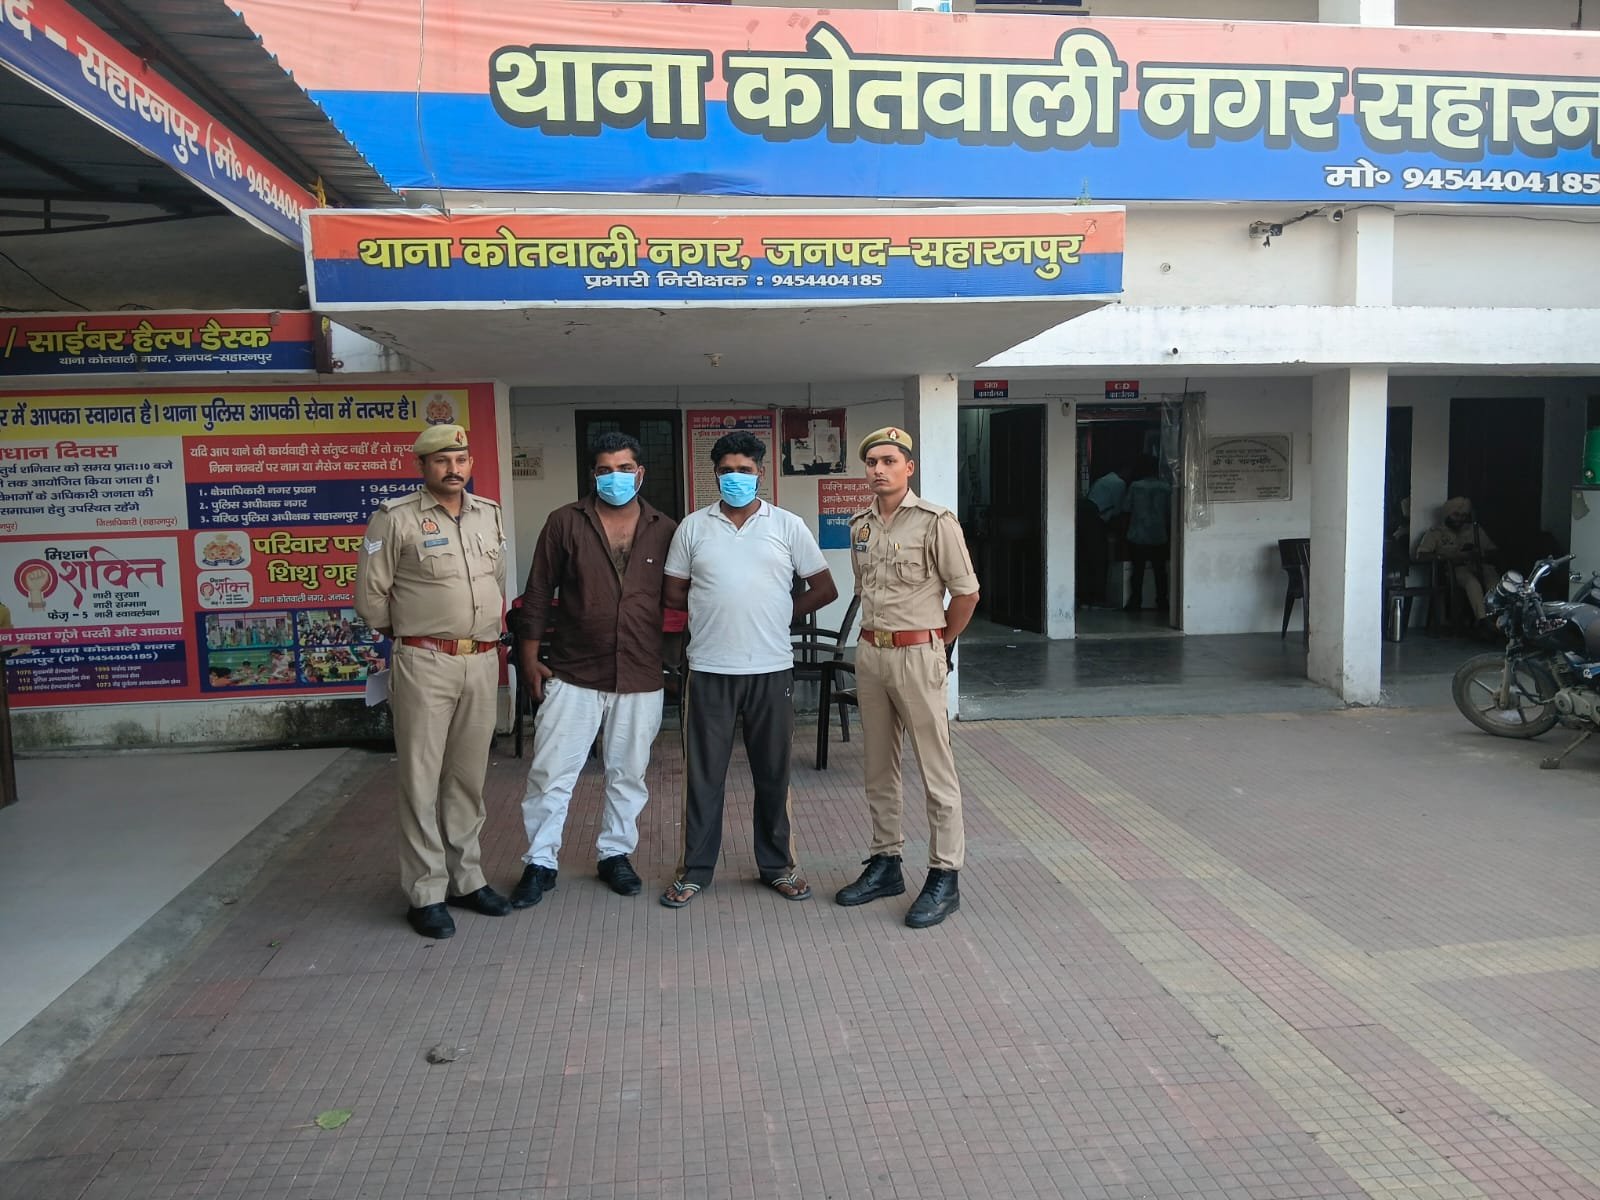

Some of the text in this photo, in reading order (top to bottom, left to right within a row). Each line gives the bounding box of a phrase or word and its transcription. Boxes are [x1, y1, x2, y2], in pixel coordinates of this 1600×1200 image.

[494, 48, 709, 128] थाना
[727, 27, 1123, 138] कोतवाली
[1141, 66, 1345, 138] नगर
[76, 35, 200, 164] सहारनपुर
[247, 165, 300, 225] 9454404
[1402, 167, 1600, 195] 9454404185
[358, 238, 453, 269] थाना
[461, 225, 639, 269] कोतवाली
[647, 238, 752, 270] नगर,
[584, 271, 650, 288] प्रभारी
[656, 270, 749, 287] निरीक्षक
[771, 274, 883, 287] 9454404185
[27, 322, 126, 353] साईबर
[132, 320, 193, 352] हैल्प
[200, 318, 272, 351] डैस्क
[59, 356, 85, 365] थाना
[88, 353, 138, 364] कोतवाली
[140, 355, 171, 363] नगर,
[11, 402, 27, 425] में
[30, 407, 81, 426] आपका
[84, 406, 137, 425] स्वागत
[162, 405, 197, 422] थाना
[201, 397, 245, 431] पुलिस
[250, 396, 300, 423] आपकी
[304, 397, 334, 422] सेवा
[338, 396, 353, 420] में
[356, 401, 394, 419] तत्पर
[55, 441, 118, 459] दिवस
[190, 440, 415, 459] यदि आप थाने की कार्यवाही से संतुष्ट नहीं हैं तो कृप्य
[0, 463, 17, 478] तुर्थ
[20, 463, 61, 474] शनिवार
[64, 463, 79, 472] को
[82, 463, 111, 472] समय
[153, 460, 173, 470] बजे
[209, 461, 233, 473] निम्न
[235, 460, 264, 473] नम्बरों
[266, 463, 279, 472] पर
[280, 462, 299, 472] नाम
[302, 462, 313, 471] या
[315, 459, 341, 472] मैसेज
[343, 461, 360, 470] कर
[361, 458, 387, 471] सकते
[8, 479, 28, 488] तक
[31, 475, 81, 487] आयोजित
[84, 474, 112, 486] किया
[115, 476, 142, 485] जाता
[35, 491, 48, 500] के
[50, 488, 98, 500] अधिकारी
[101, 490, 135, 498] जनता
[137, 487, 153, 497] की
[267, 486, 291, 494] नगर
[293, 486, 317, 495] प्रथम
[370, 484, 425, 493] 945440
[0, 501, 140, 517] समाधान हेतु उपस्थित रहेंगे
[211, 499, 240, 513] पुलिस
[242, 498, 282, 509] अधीक्षक
[284, 499, 307, 508] नगर
[212, 512, 239, 523] वरिष्ठ
[241, 511, 269, 525] पुलिस
[271, 510, 310, 521] अधीक्षक
[313, 511, 358, 523] सहारनपुर
[254, 532, 365, 555] परिवार पर
[44, 548, 89, 561] मिशन
[59, 546, 166, 609] शक्ति
[267, 560, 320, 590] शिशु
[92, 590, 111, 599] नारी
[276, 593, 306, 603] कोतवाली
[93, 600, 112, 608] नारी
[82, 611, 88, 619] 5
[15, 631, 52, 643] प्रकाश
[54, 629, 79, 643] गूंजे
[81, 626, 111, 638] धरती
[114, 626, 138, 637] और
[140, 627, 182, 636] आकाश
[83, 643, 140, 653] कोतवाली
[5, 657, 55, 666] हारनपुर
